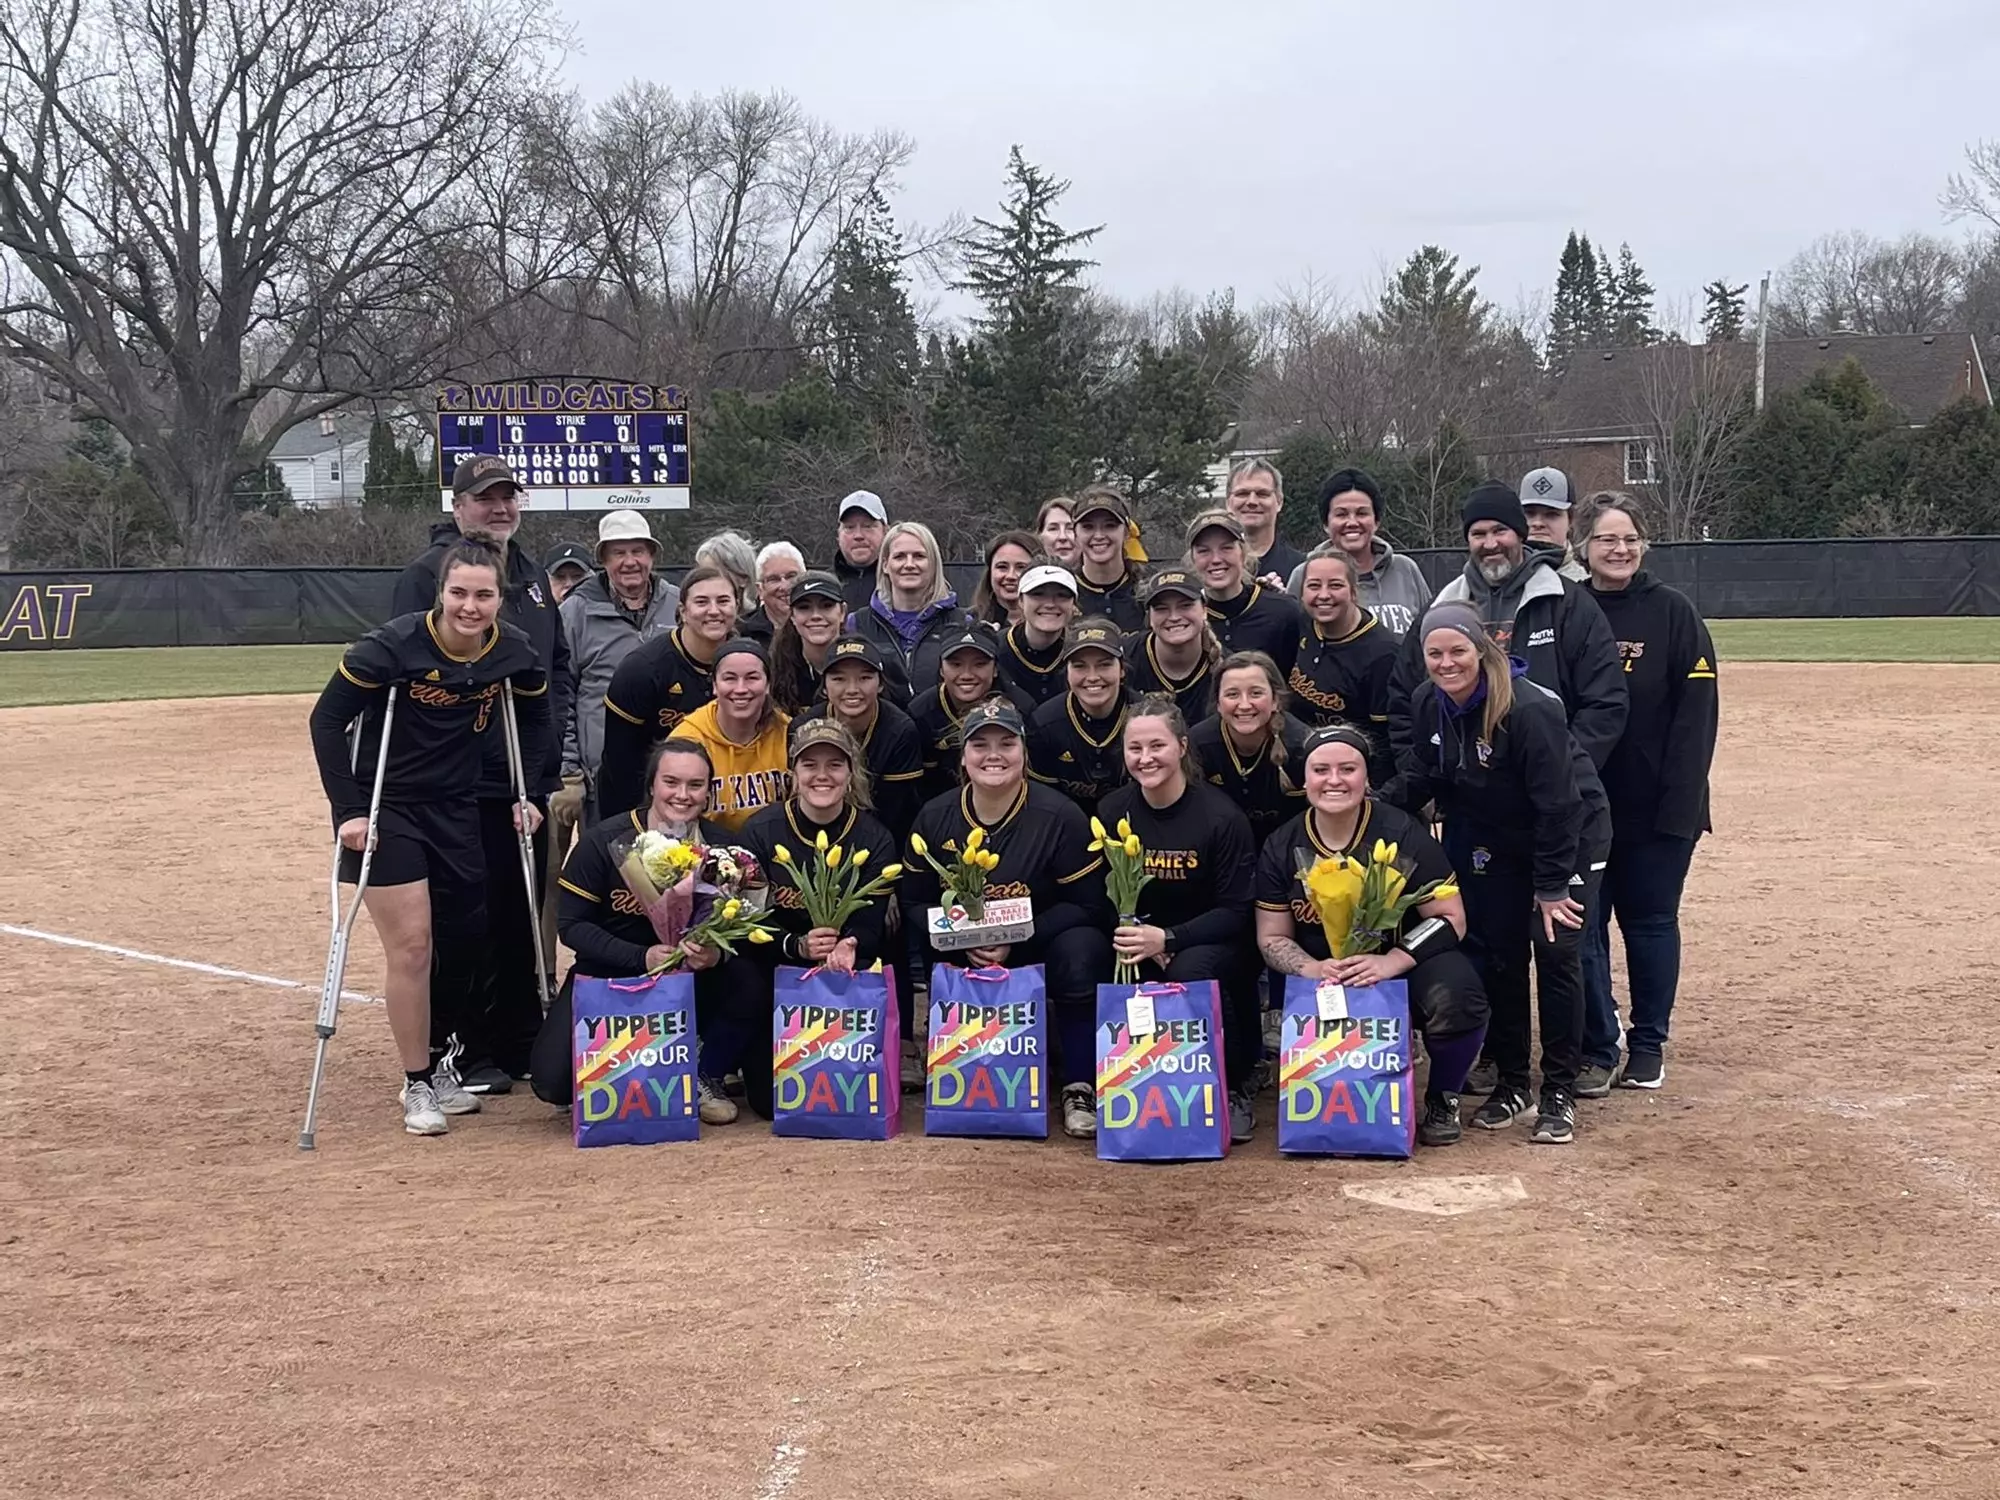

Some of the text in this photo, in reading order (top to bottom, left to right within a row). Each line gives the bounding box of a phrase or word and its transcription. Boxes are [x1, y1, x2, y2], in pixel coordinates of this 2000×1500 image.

[472, 384, 653, 410] WILDCATS
[457, 415, 484, 425] AT BAT
[506, 415, 526, 425] BALL
[556, 415, 586, 425] STRIKE
[614, 415, 632, 425] OUT
[667, 415, 683, 425] H/E
[511, 426, 523, 443] 0
[566, 426, 577, 443] 0
[617, 426, 629, 443] 0
[620, 445, 640, 453] RUNS
[648, 445, 665, 453] HITS
[607, 494, 651, 504] Collins
[1145, 849, 1198, 868] KATE'S
[583, 1010, 688, 1039] YIPPEE!
[780, 1004, 878, 1032] YIPPEE!
[938, 1000, 1037, 1026] YIPPEE!
[777, 1039, 875, 1063] IT'S YOUR
[934, 1035, 1037, 1055] IT'S YOUR
[583, 1044, 689, 1070] IT'S YOUR
[1104, 1053, 1212, 1076] IT'S YOUR
[1289, 1048, 1401, 1072] IT'S YOUR
[583, 1073, 693, 1122] DAY!
[777, 1067, 878, 1115] DAY!
[931, 1065, 1039, 1108] DAY!
[1104, 1083, 1214, 1129] DAY!
[1287, 1079, 1401, 1126] DAY!
